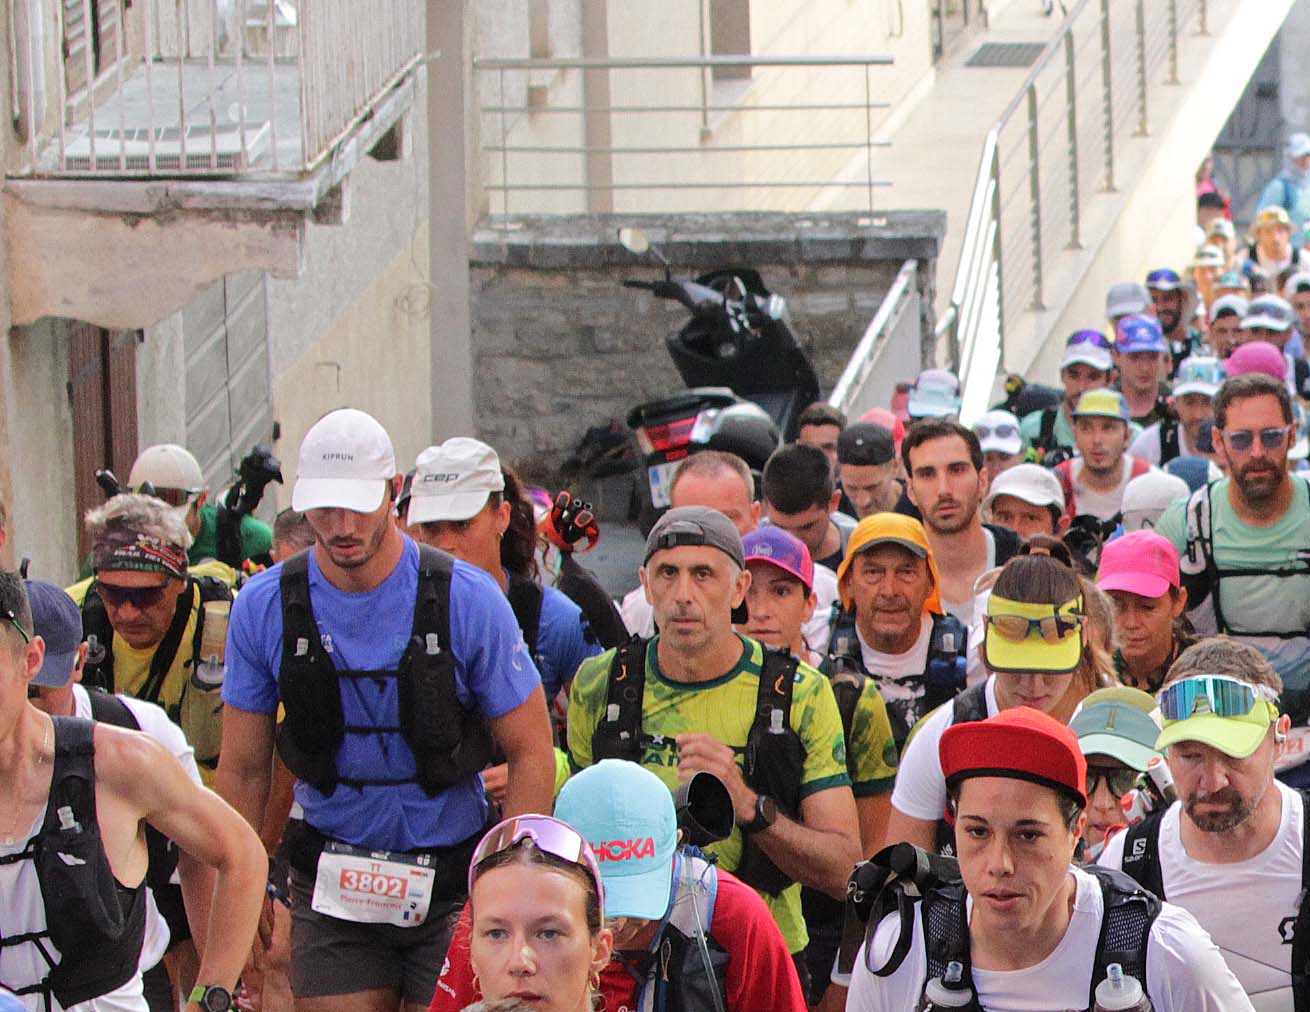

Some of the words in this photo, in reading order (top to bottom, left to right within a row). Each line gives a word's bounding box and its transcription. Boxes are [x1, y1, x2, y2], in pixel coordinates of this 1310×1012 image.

[423, 473, 459, 482] cep
[589, 836, 656, 862] HOKA
[343, 870, 404, 898] 3802
